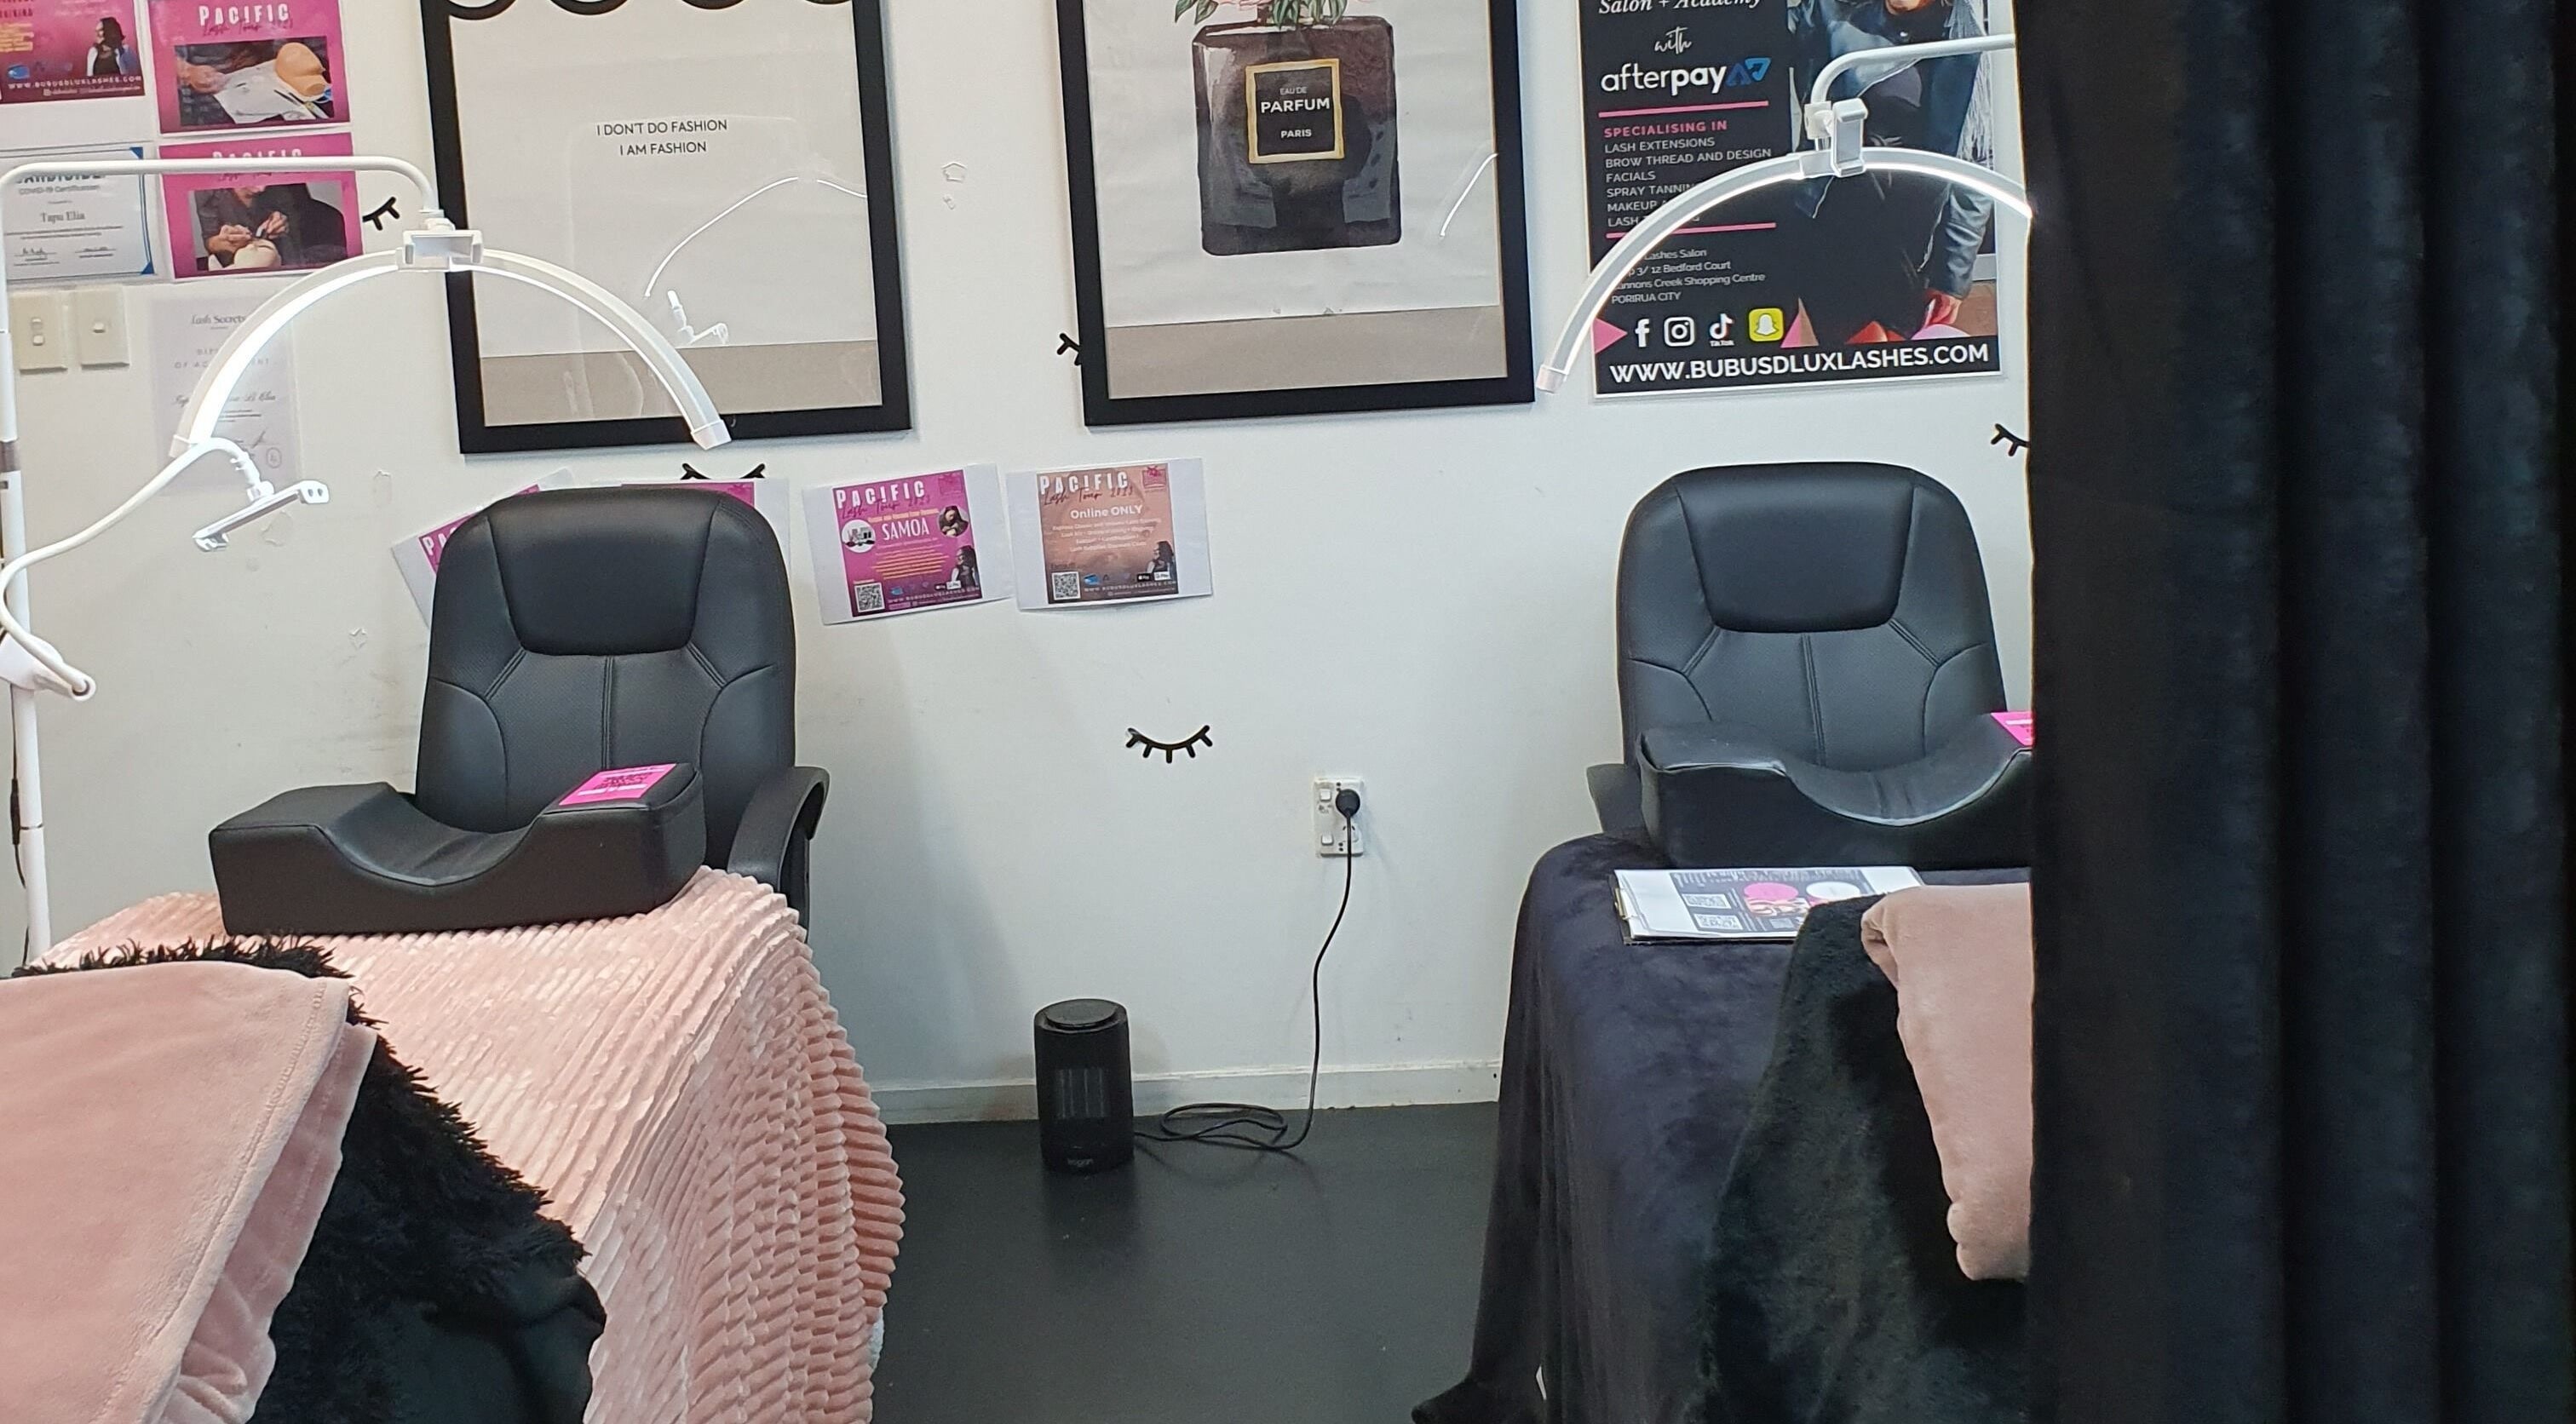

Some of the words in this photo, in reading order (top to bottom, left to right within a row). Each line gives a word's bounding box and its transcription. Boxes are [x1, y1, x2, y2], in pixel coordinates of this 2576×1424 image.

[198, 3, 289, 26] PACIFIC
[1599, 0, 1653, 14] Salon
[1654, 26, 1693, 55] with
[1601, 62, 1728, 96] afterpay
[1261, 98, 1330, 113] PARFUM
[604, 123, 644, 135] DON'T
[647, 122, 668, 134] DO
[671, 119, 727, 132] FASHION
[1280, 129, 1312, 138] PARIS
[1604, 122, 1706, 138] SPECIALISING
[1711, 120, 1728, 131] IN
[627, 144, 647, 155] AM
[650, 141, 707, 154] FASHION
[1605, 143, 1636, 154] LASH
[1640, 137, 1716, 152] EXTENSIONS
[1606, 158, 1642, 169] BROW
[1646, 153, 1693, 165] THREAD
[1697, 151, 1723, 162] AND
[1727, 148, 1772, 160] DESIGN
[1606, 171, 1656, 183] FACIALS
[1607, 187, 1645, 198] SPRAY
[1607, 200, 1658, 212] MAKEUP
[1607, 216, 1638, 228] LASH
[1679, 249, 1707, 259] Salon
[1663, 262, 1702, 273] Bedford
[1704, 261, 1732, 271] Court
[1653, 278, 1682, 288] Creek
[1684, 274, 1731, 289] Shopping
[1732, 273, 1765, 283] Centre
[1612, 293, 1657, 304] PORIRUA
[1657, 291, 1682, 301] CITY
[1609, 344, 1988, 383] WWW.BUBUSDLUXLASHES.COM
[1039, 471, 1128, 495] PACIFIC
[836, 480, 925, 509] PACIFIC
[1070, 508, 1108, 519] Online
[1110, 504, 1143, 516] ONLY
[882, 517, 929, 540] SAMOA
